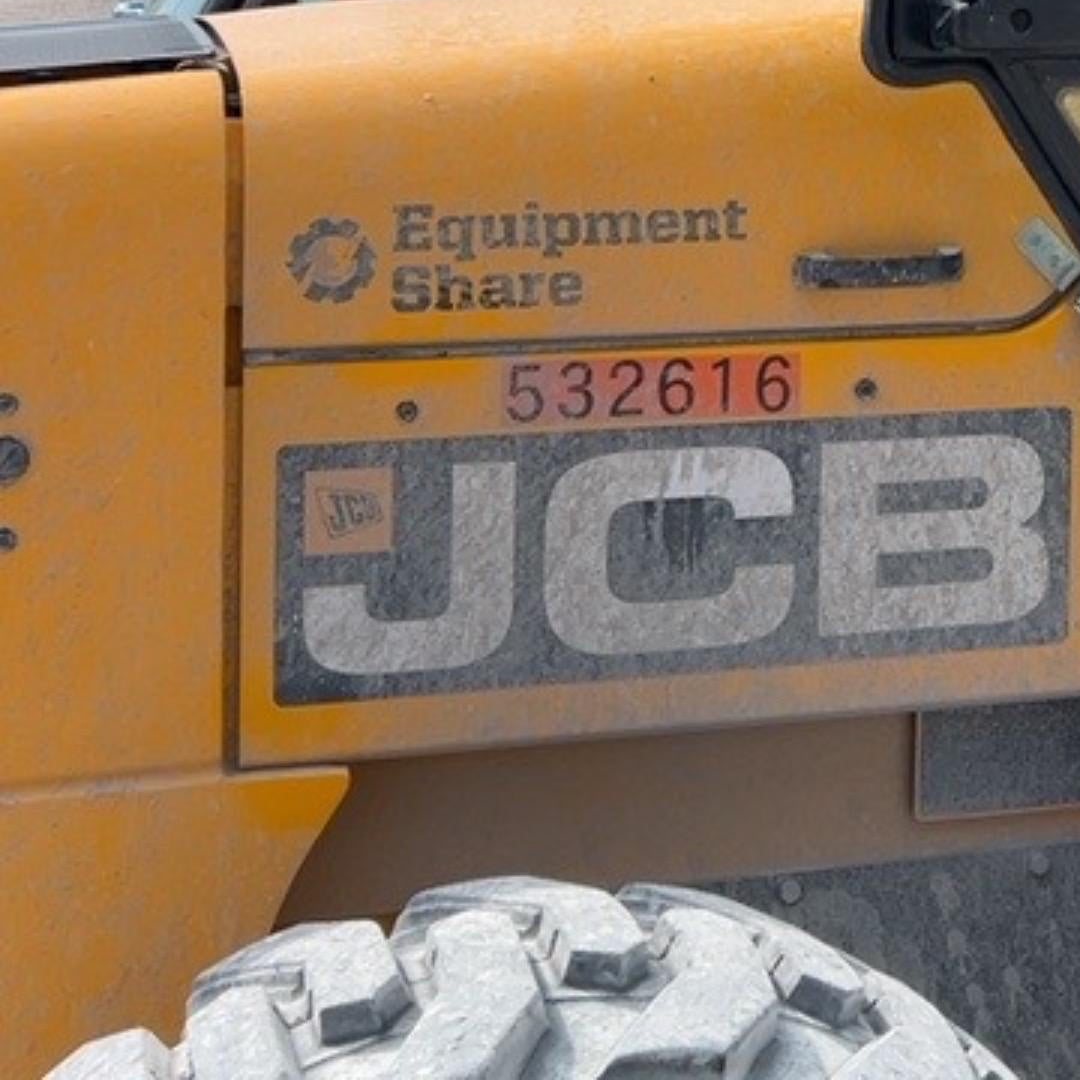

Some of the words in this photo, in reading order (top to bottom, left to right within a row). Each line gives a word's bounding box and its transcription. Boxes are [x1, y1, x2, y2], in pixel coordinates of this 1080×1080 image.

[391, 199, 747, 257] Equipment
[391, 265, 584, 312] Share
[507, 354, 793, 421] 532616
[302, 432, 1048, 676] JCB
